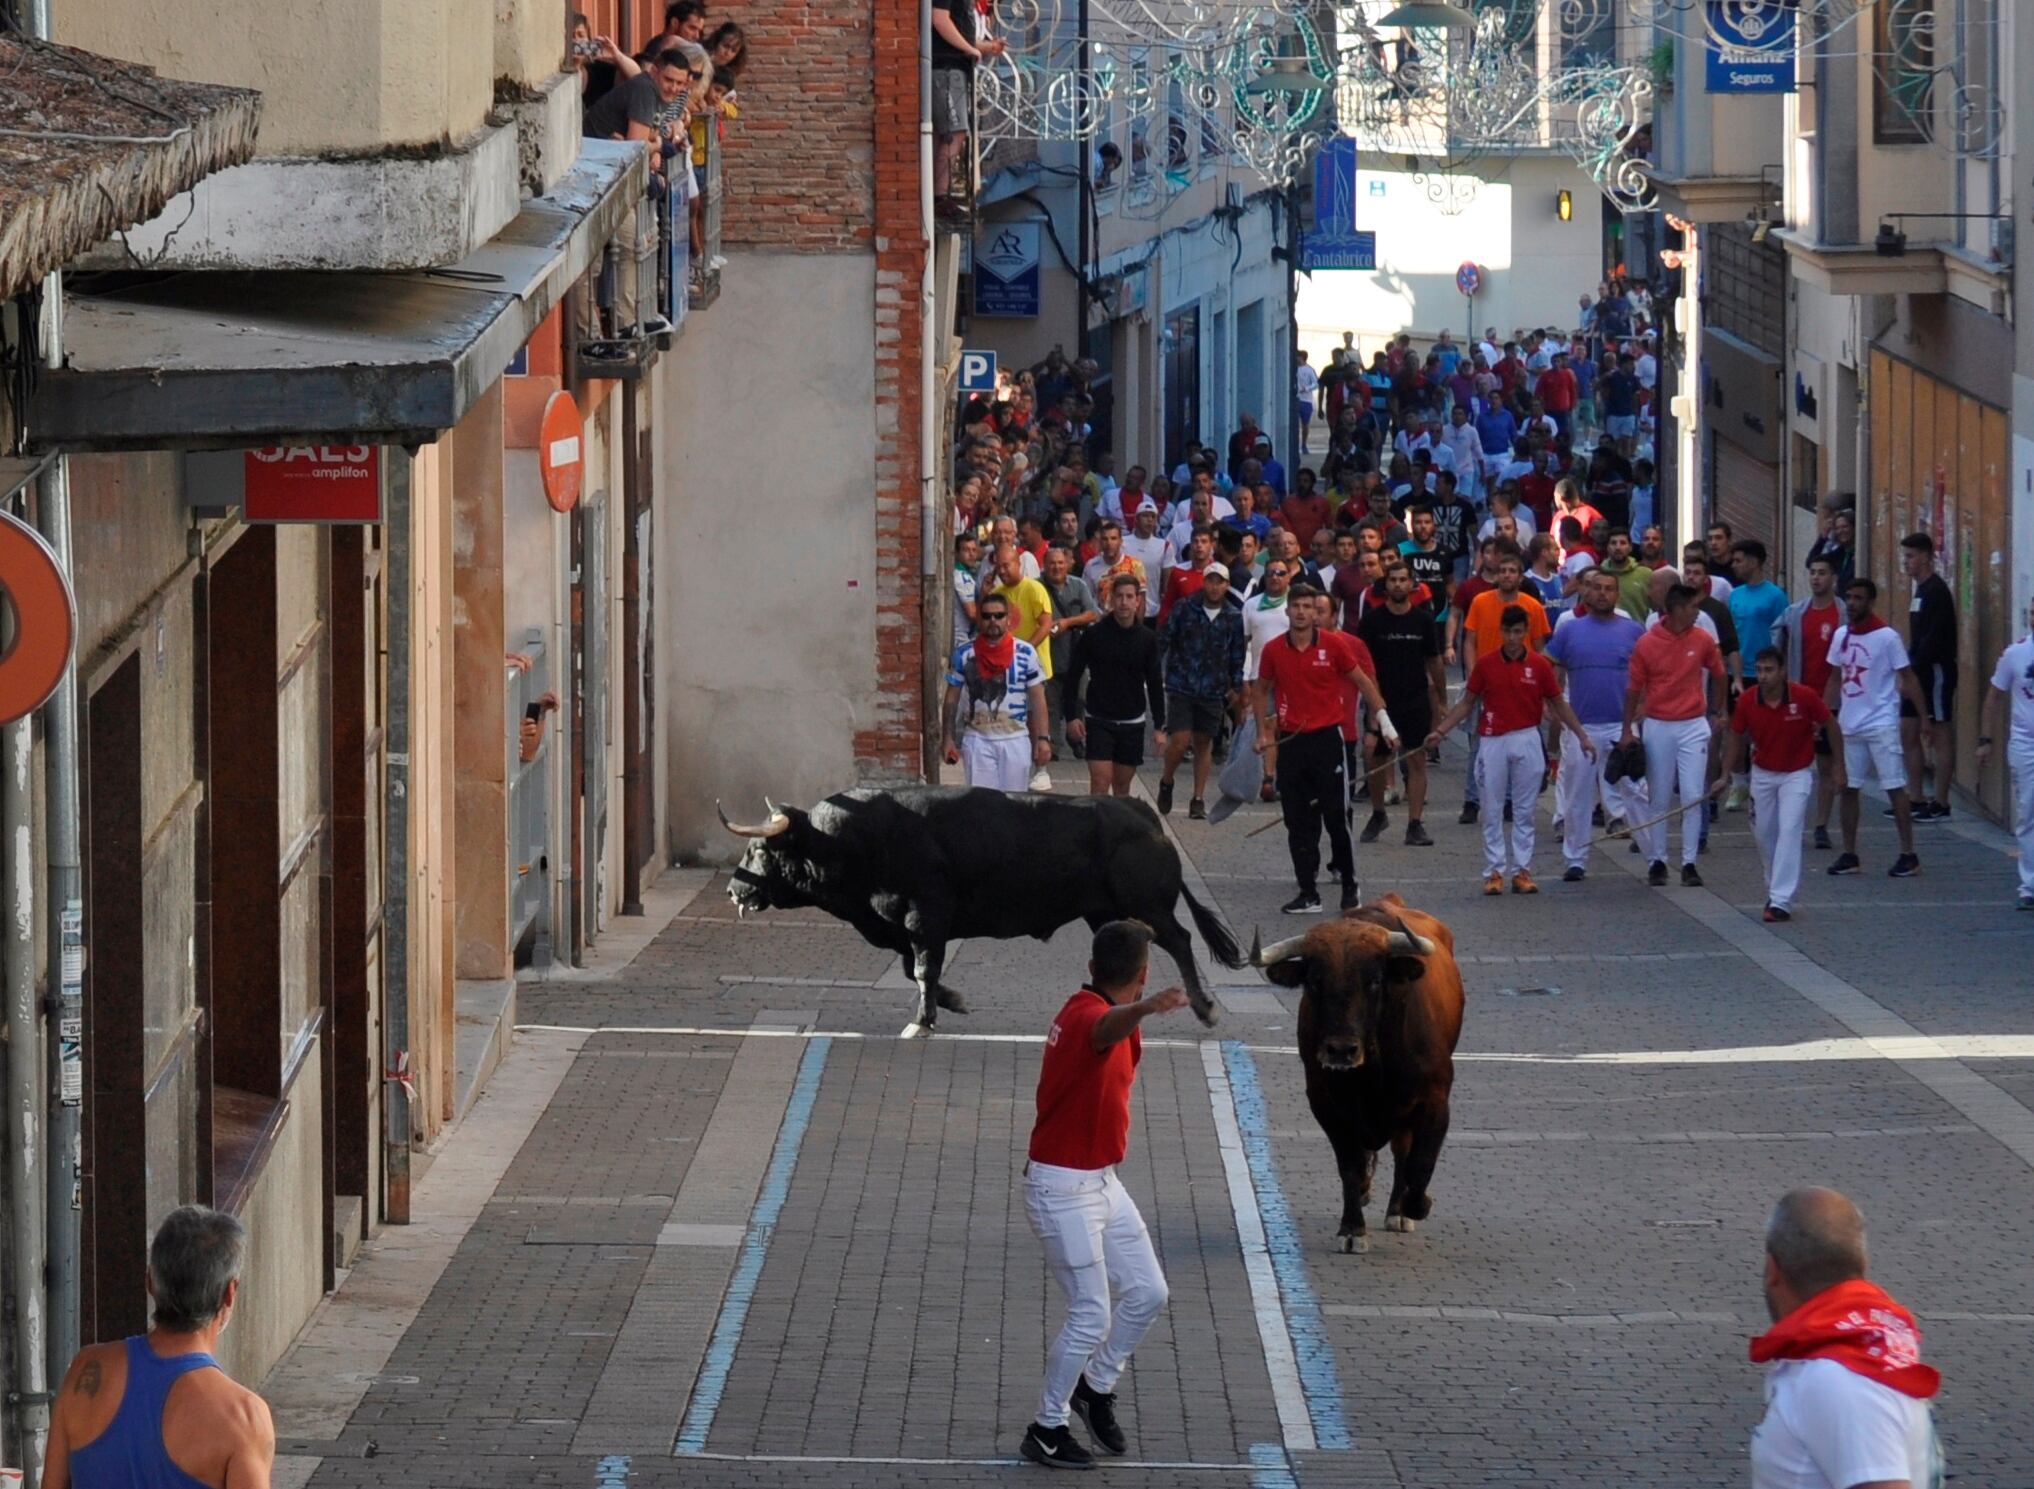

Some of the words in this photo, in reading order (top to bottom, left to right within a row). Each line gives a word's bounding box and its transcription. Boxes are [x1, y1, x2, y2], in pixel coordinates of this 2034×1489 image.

[1729, 71, 1774, 86] Seguros
[964, 355, 988, 386] P
[311, 466, 368, 480] amplifon
[1413, 558, 1440, 570] UVa
